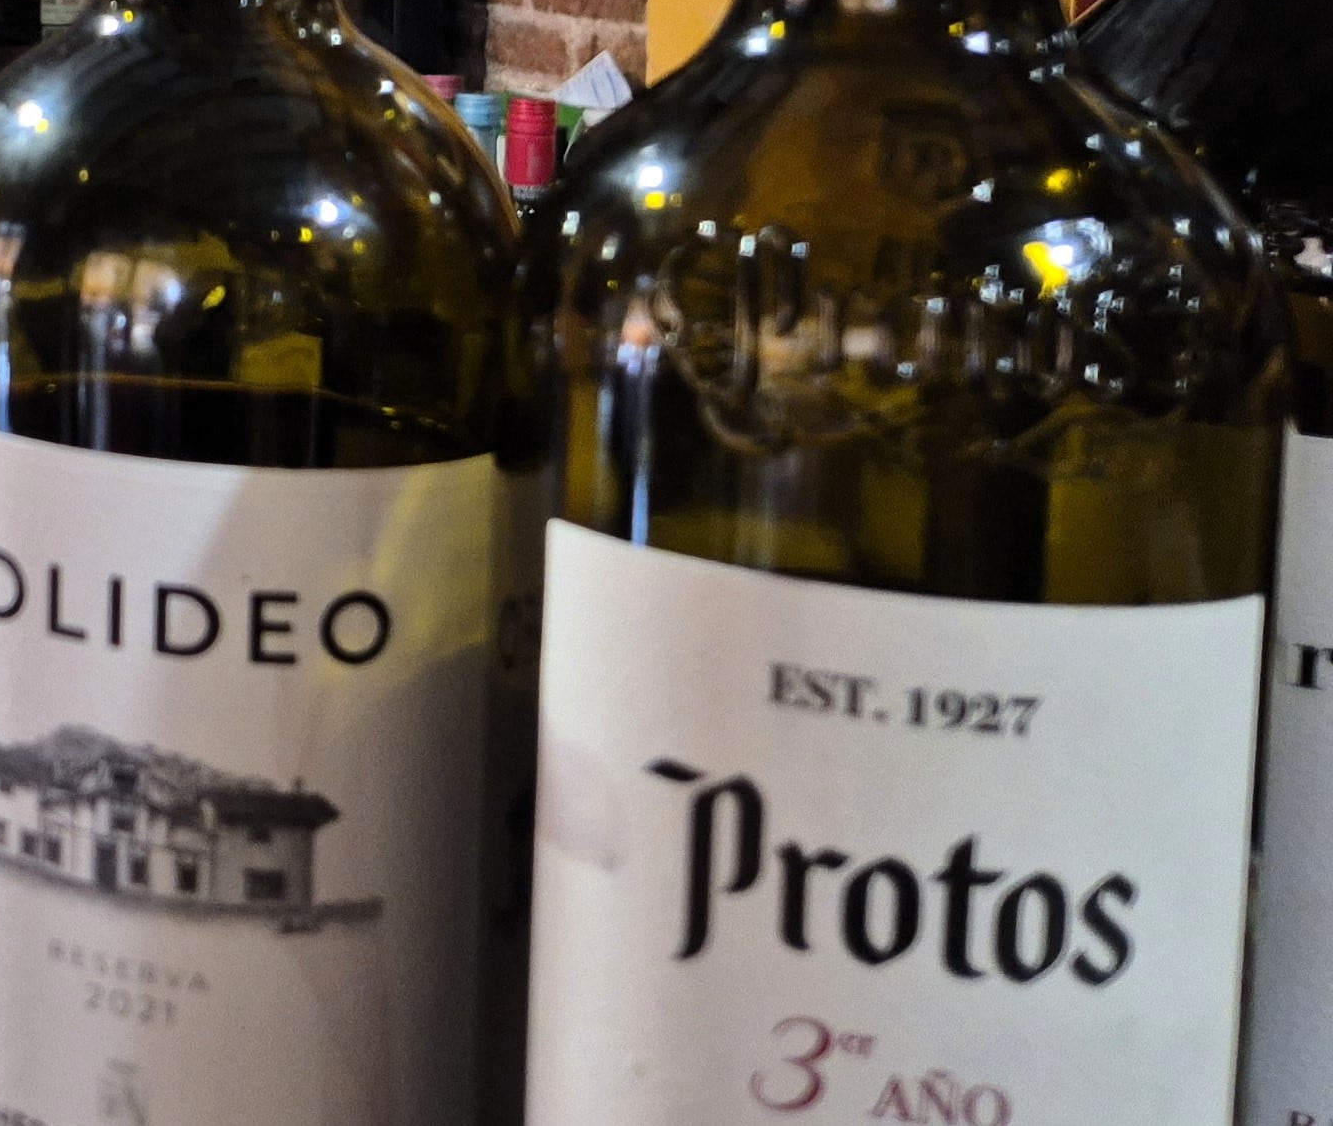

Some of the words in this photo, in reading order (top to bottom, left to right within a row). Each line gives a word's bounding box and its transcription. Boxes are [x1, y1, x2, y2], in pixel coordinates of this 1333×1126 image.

[767, 660, 890, 723] EST.
[906, 686, 1044, 737] 1927
[644, 756, 1141, 987] Protos
